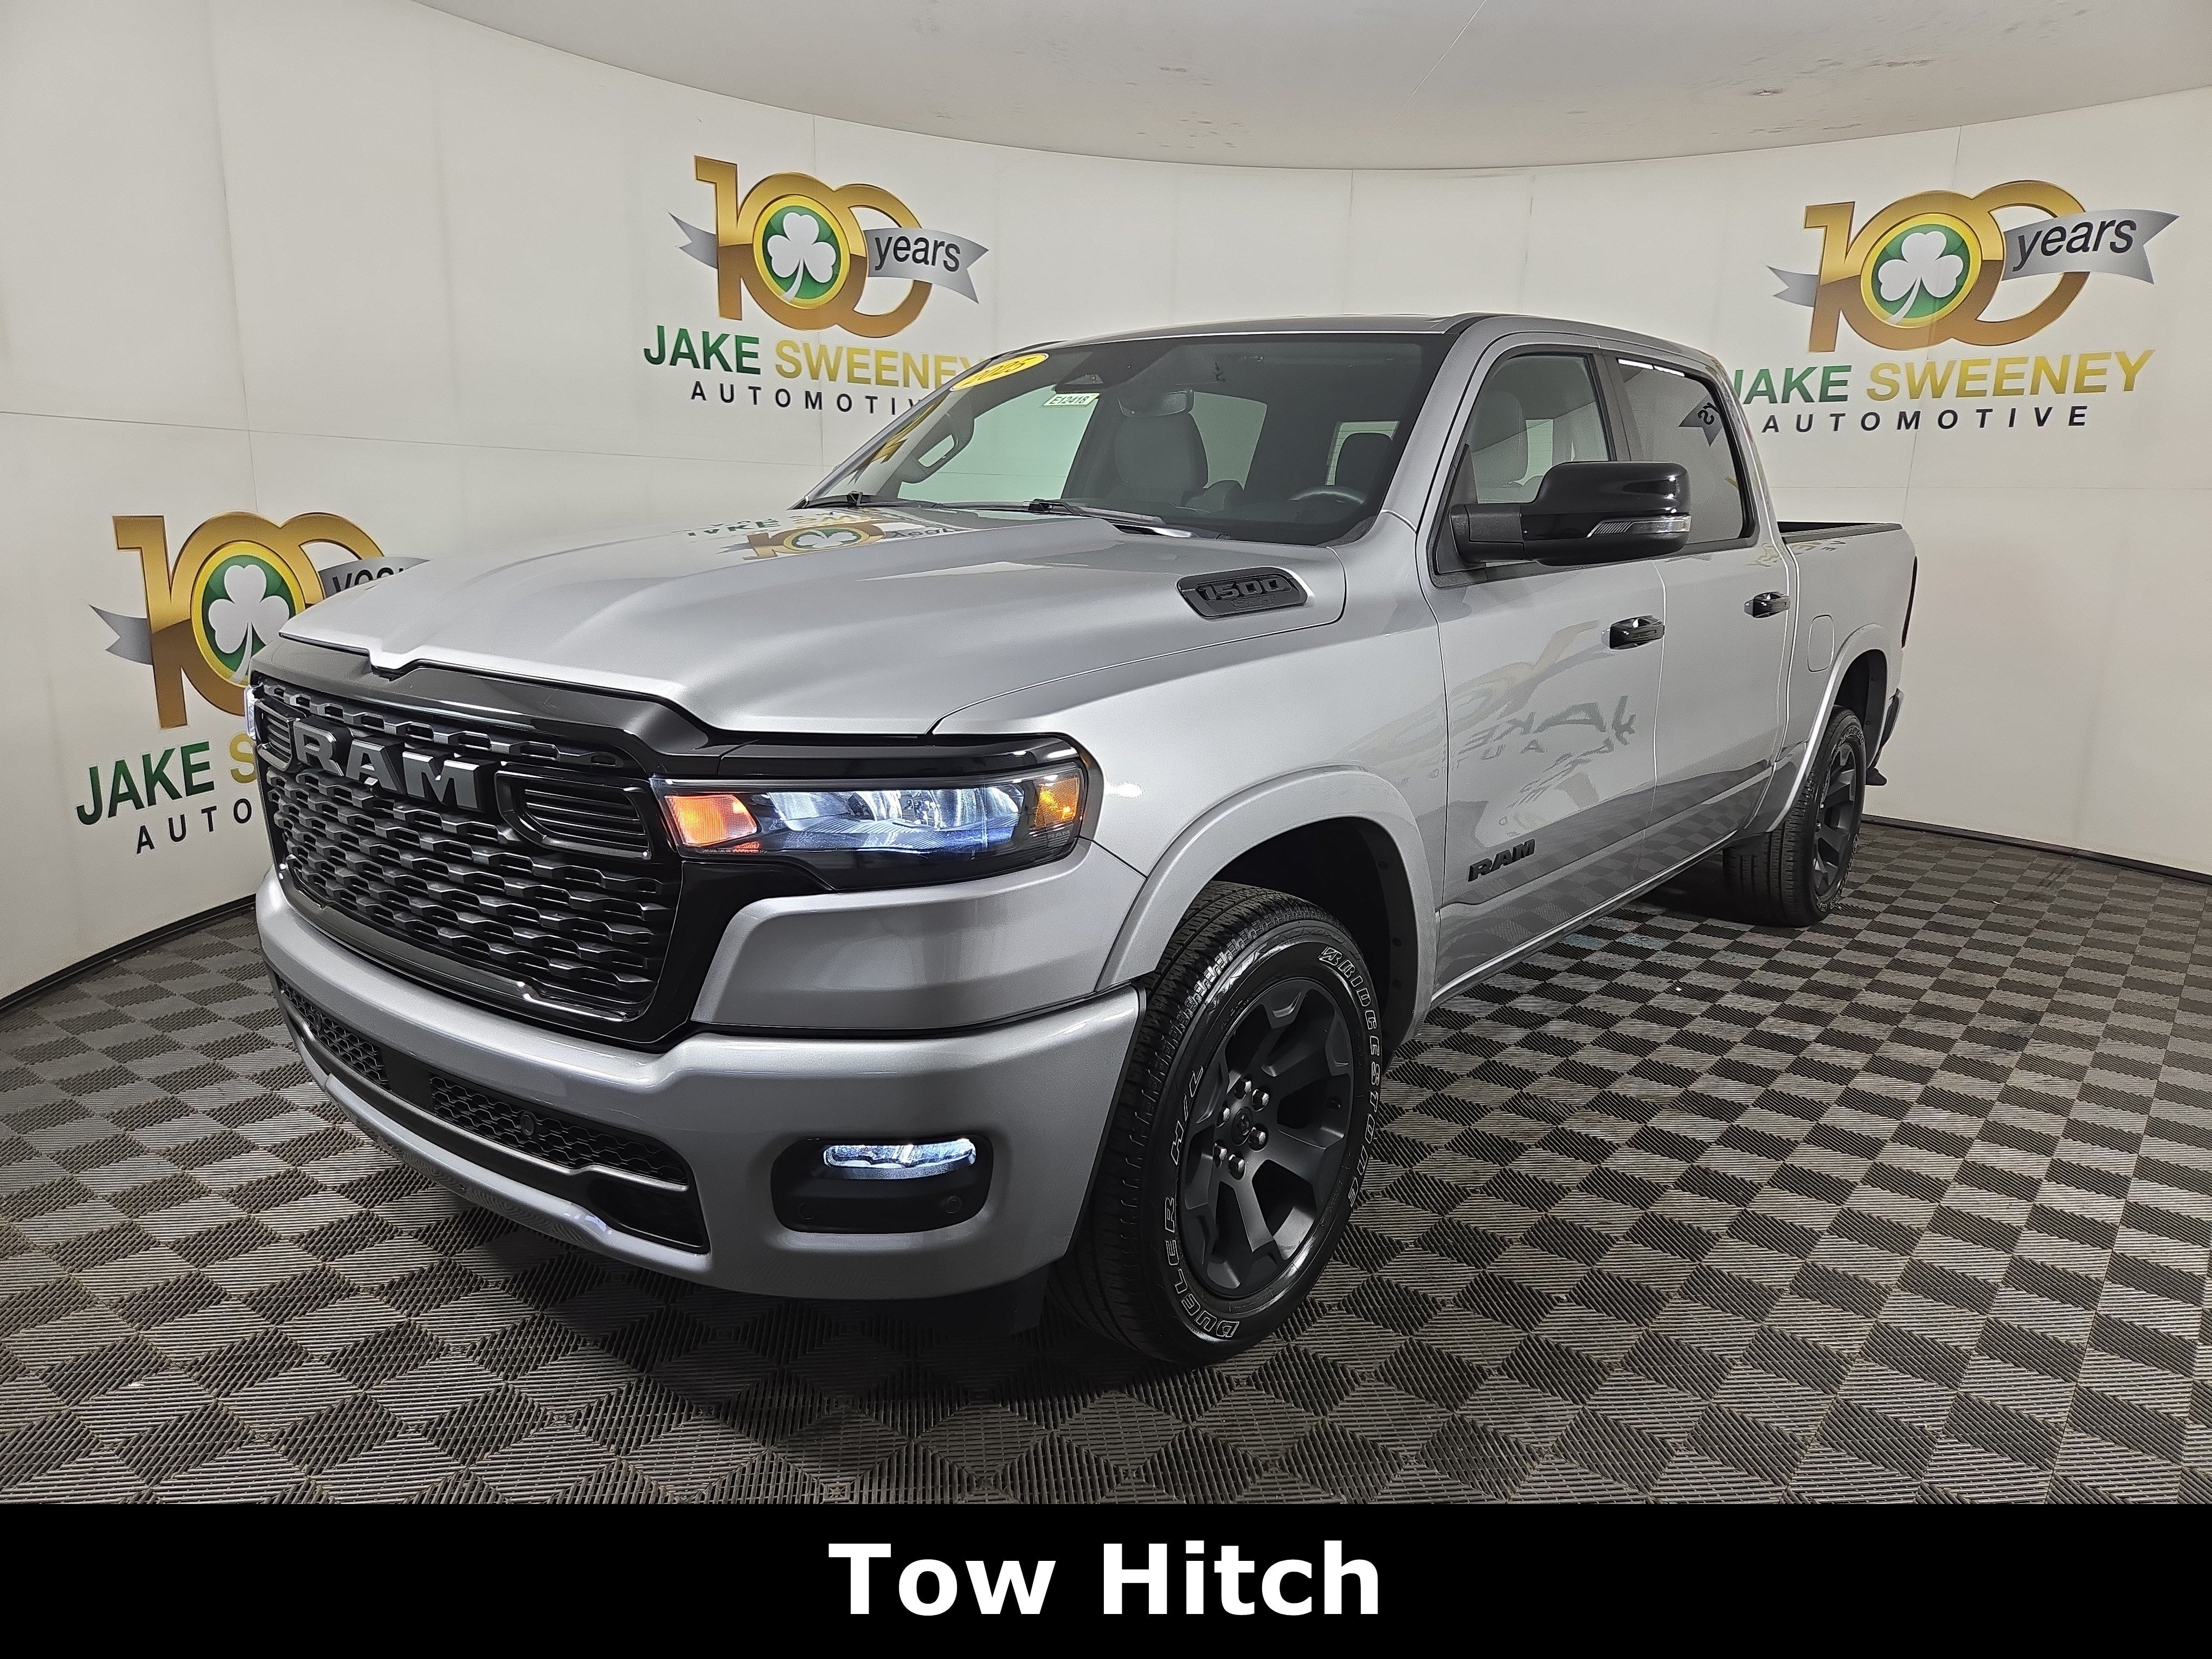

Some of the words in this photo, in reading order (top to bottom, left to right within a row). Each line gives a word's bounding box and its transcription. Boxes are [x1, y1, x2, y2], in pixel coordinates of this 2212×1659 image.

[694, 155, 933, 338] 100
[874, 234, 961, 272] years
[1804, 179, 2091, 353] 100
[2012, 216, 2137, 273] years
[644, 324, 761, 375] JAKE
[1867, 349, 2156, 402] SWEENEY
[691, 381, 922, 416] AUTOMOTI
[1049, 395, 1090, 405] E12418
[1762, 404, 2089, 434] AUTOMOTIVE
[1199, 578, 1288, 600] 1500
[76, 741, 215, 826] JAKE
[293, 718, 483, 809] RAM
[1468, 839, 1535, 882] RAM
[1317, 946, 1382, 1208] BRIDGESTONE
[1171, 1066, 1204, 1166] H/L
[1165, 1197, 1240, 1338] DUELER
